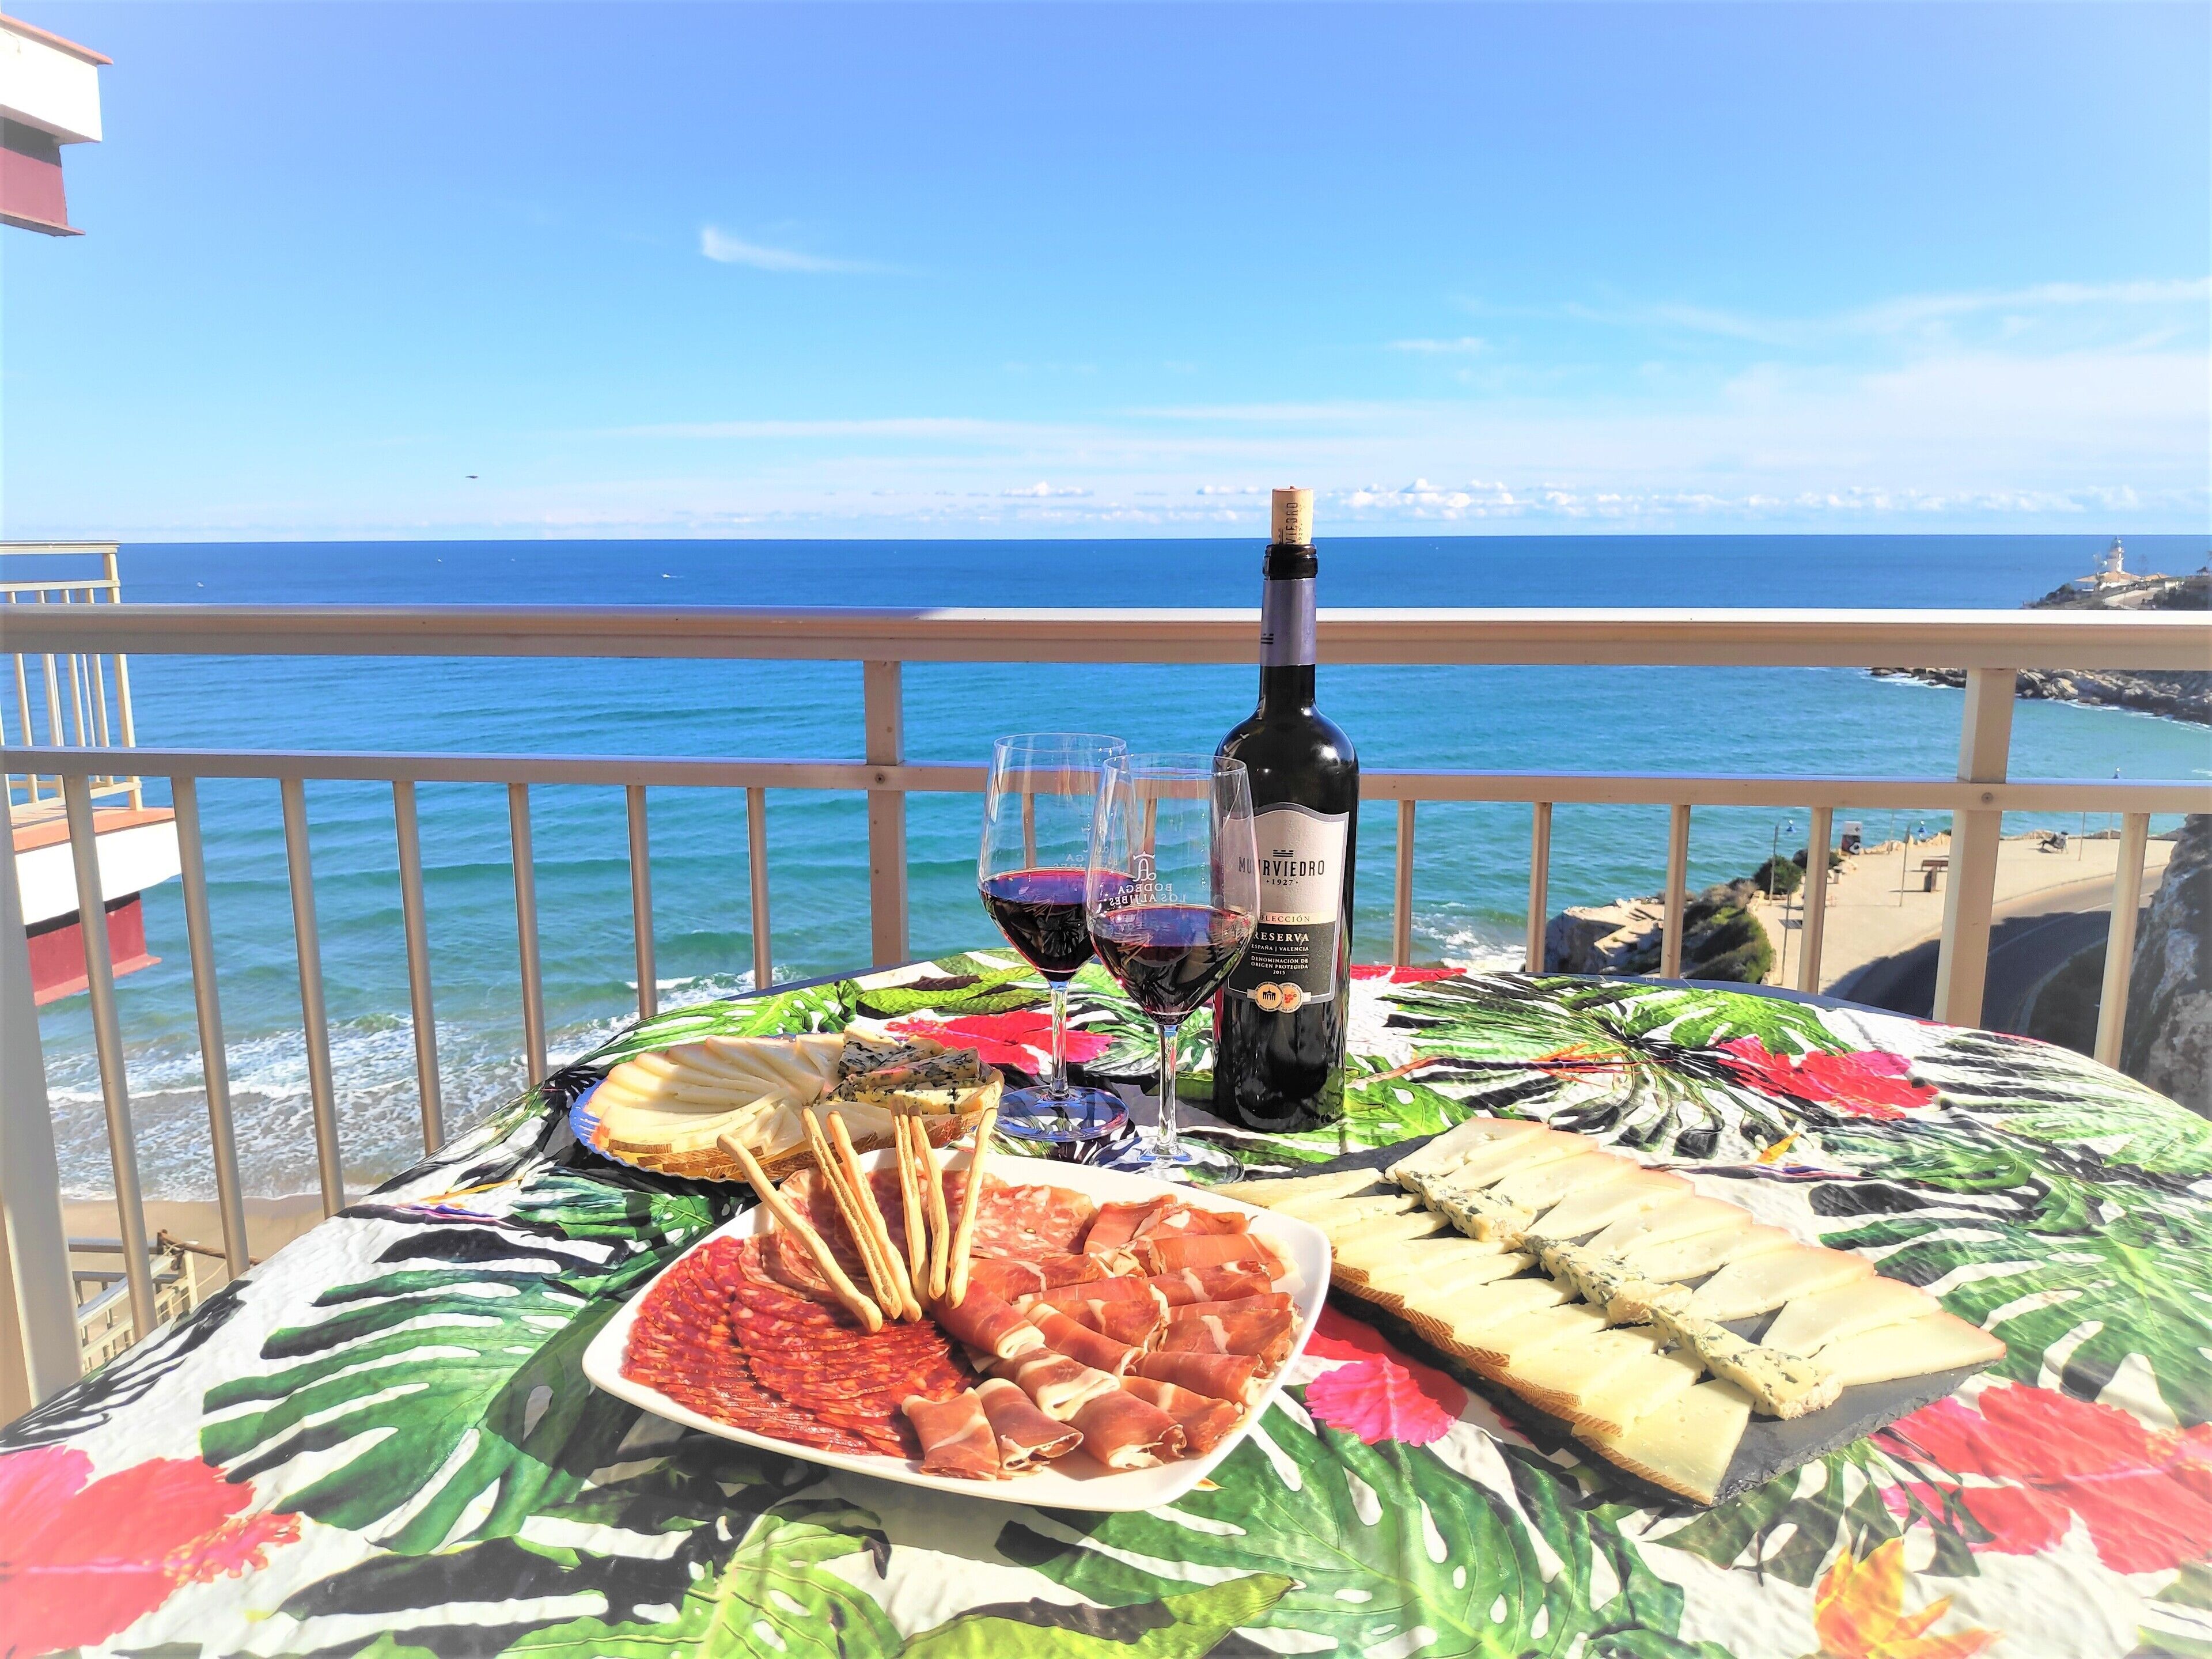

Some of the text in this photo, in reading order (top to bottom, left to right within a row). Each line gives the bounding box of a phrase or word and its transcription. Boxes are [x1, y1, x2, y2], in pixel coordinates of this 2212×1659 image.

[1286, 503, 1297, 545] VIEDRO
[1239, 857, 1324, 877] MURVIEDRO
[1260, 915, 1310, 923] OLECCIÓN
[1253, 931, 1309, 942] RESERVA
[1251, 956, 1298, 964] DENOMINACIÓN
